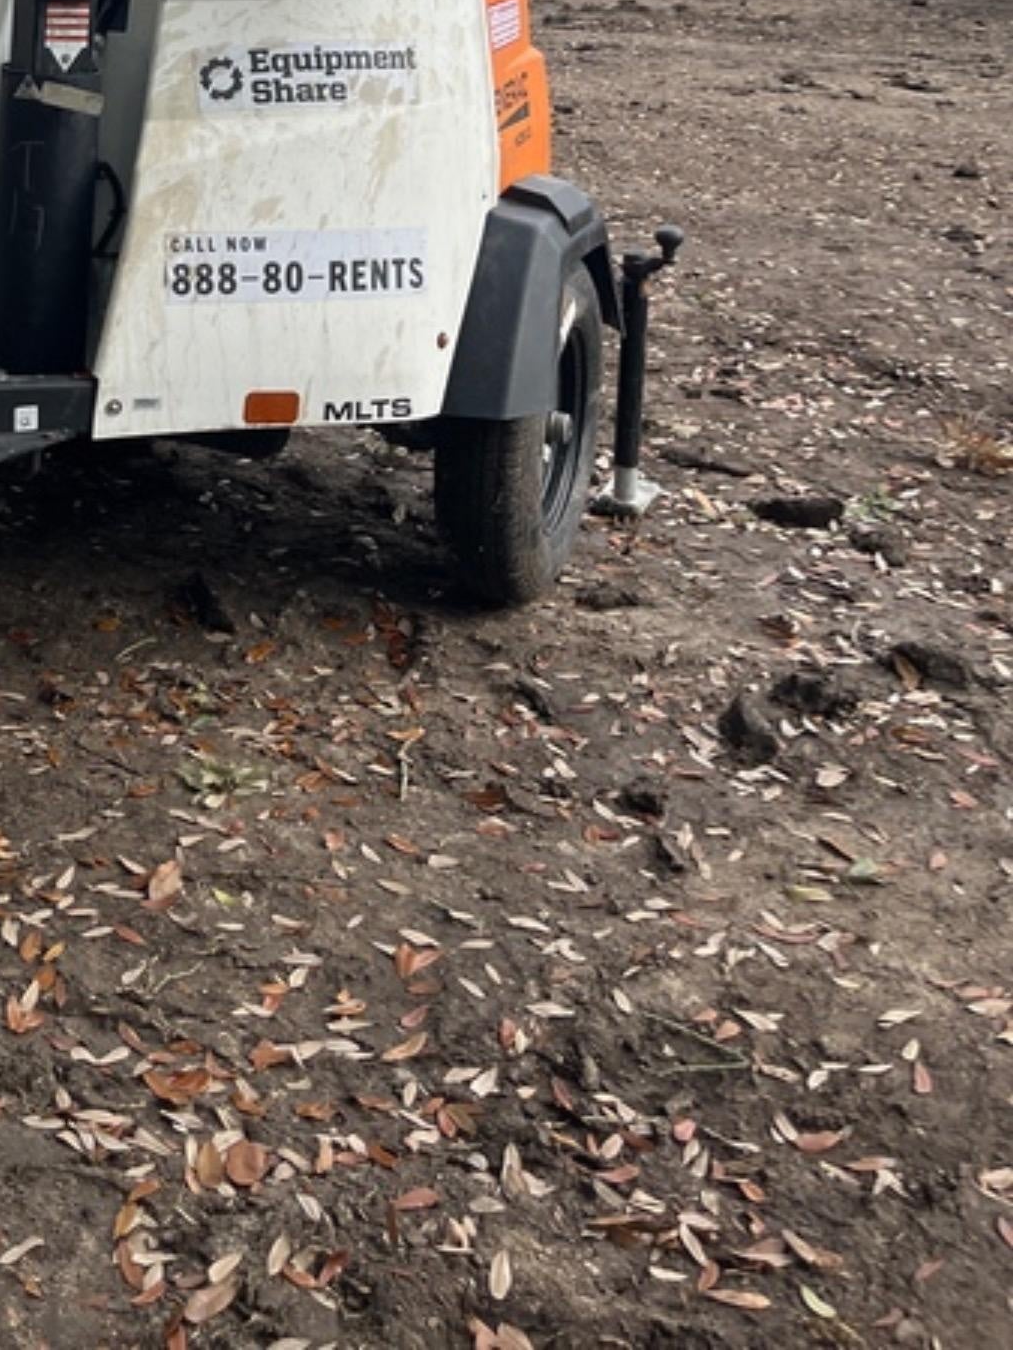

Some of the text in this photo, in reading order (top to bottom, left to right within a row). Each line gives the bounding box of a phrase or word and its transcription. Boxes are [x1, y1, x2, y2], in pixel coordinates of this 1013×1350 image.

[248, 45, 417, 78] Equipment
[250, 78, 348, 104] Share
[169, 236, 267, 253] CALL NOW
[171, 257, 424, 296] 888-80-RENTS
[323, 398, 412, 422] MLTS
